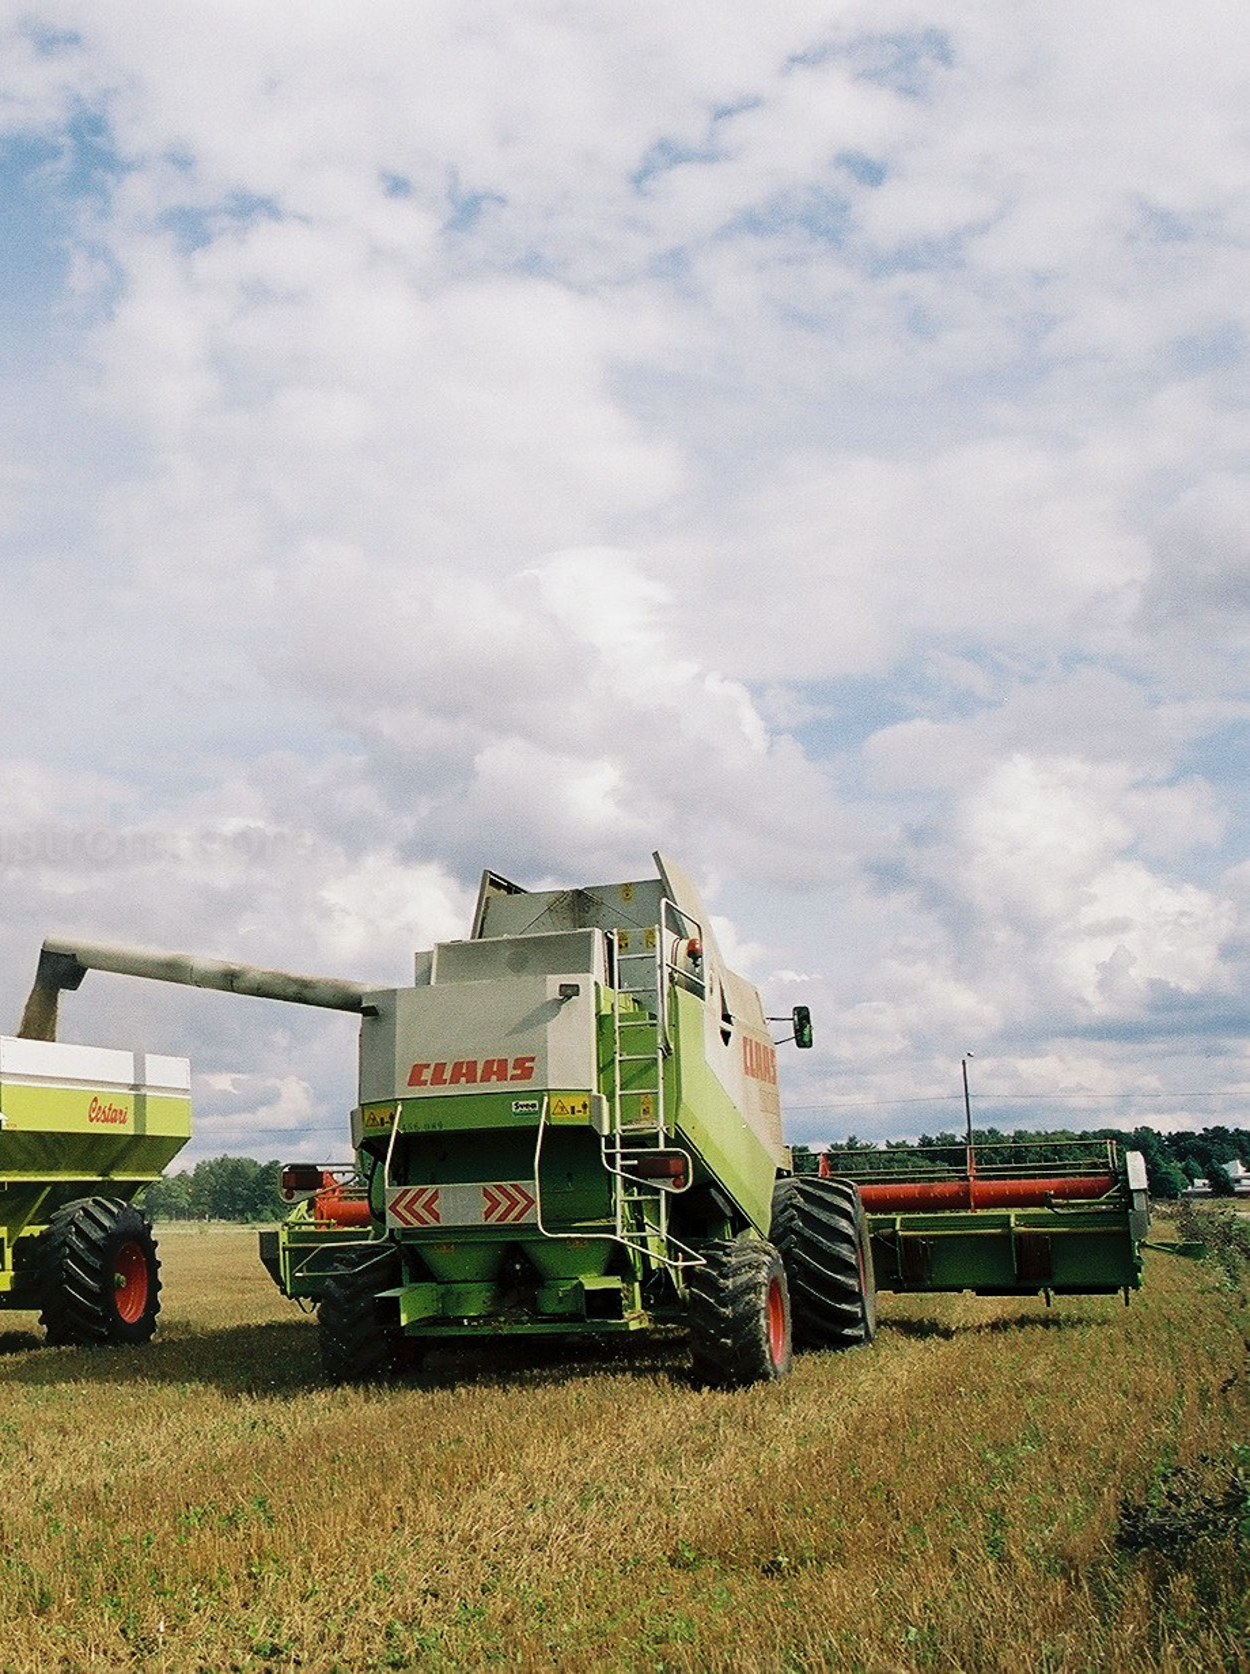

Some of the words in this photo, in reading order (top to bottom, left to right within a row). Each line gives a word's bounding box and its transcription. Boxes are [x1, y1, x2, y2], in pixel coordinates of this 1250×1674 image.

[407, 1056, 536, 1087] CLAAS
[743, 1036, 777, 1086] CLAAS
[88, 1096, 129, 1126] Cestari
